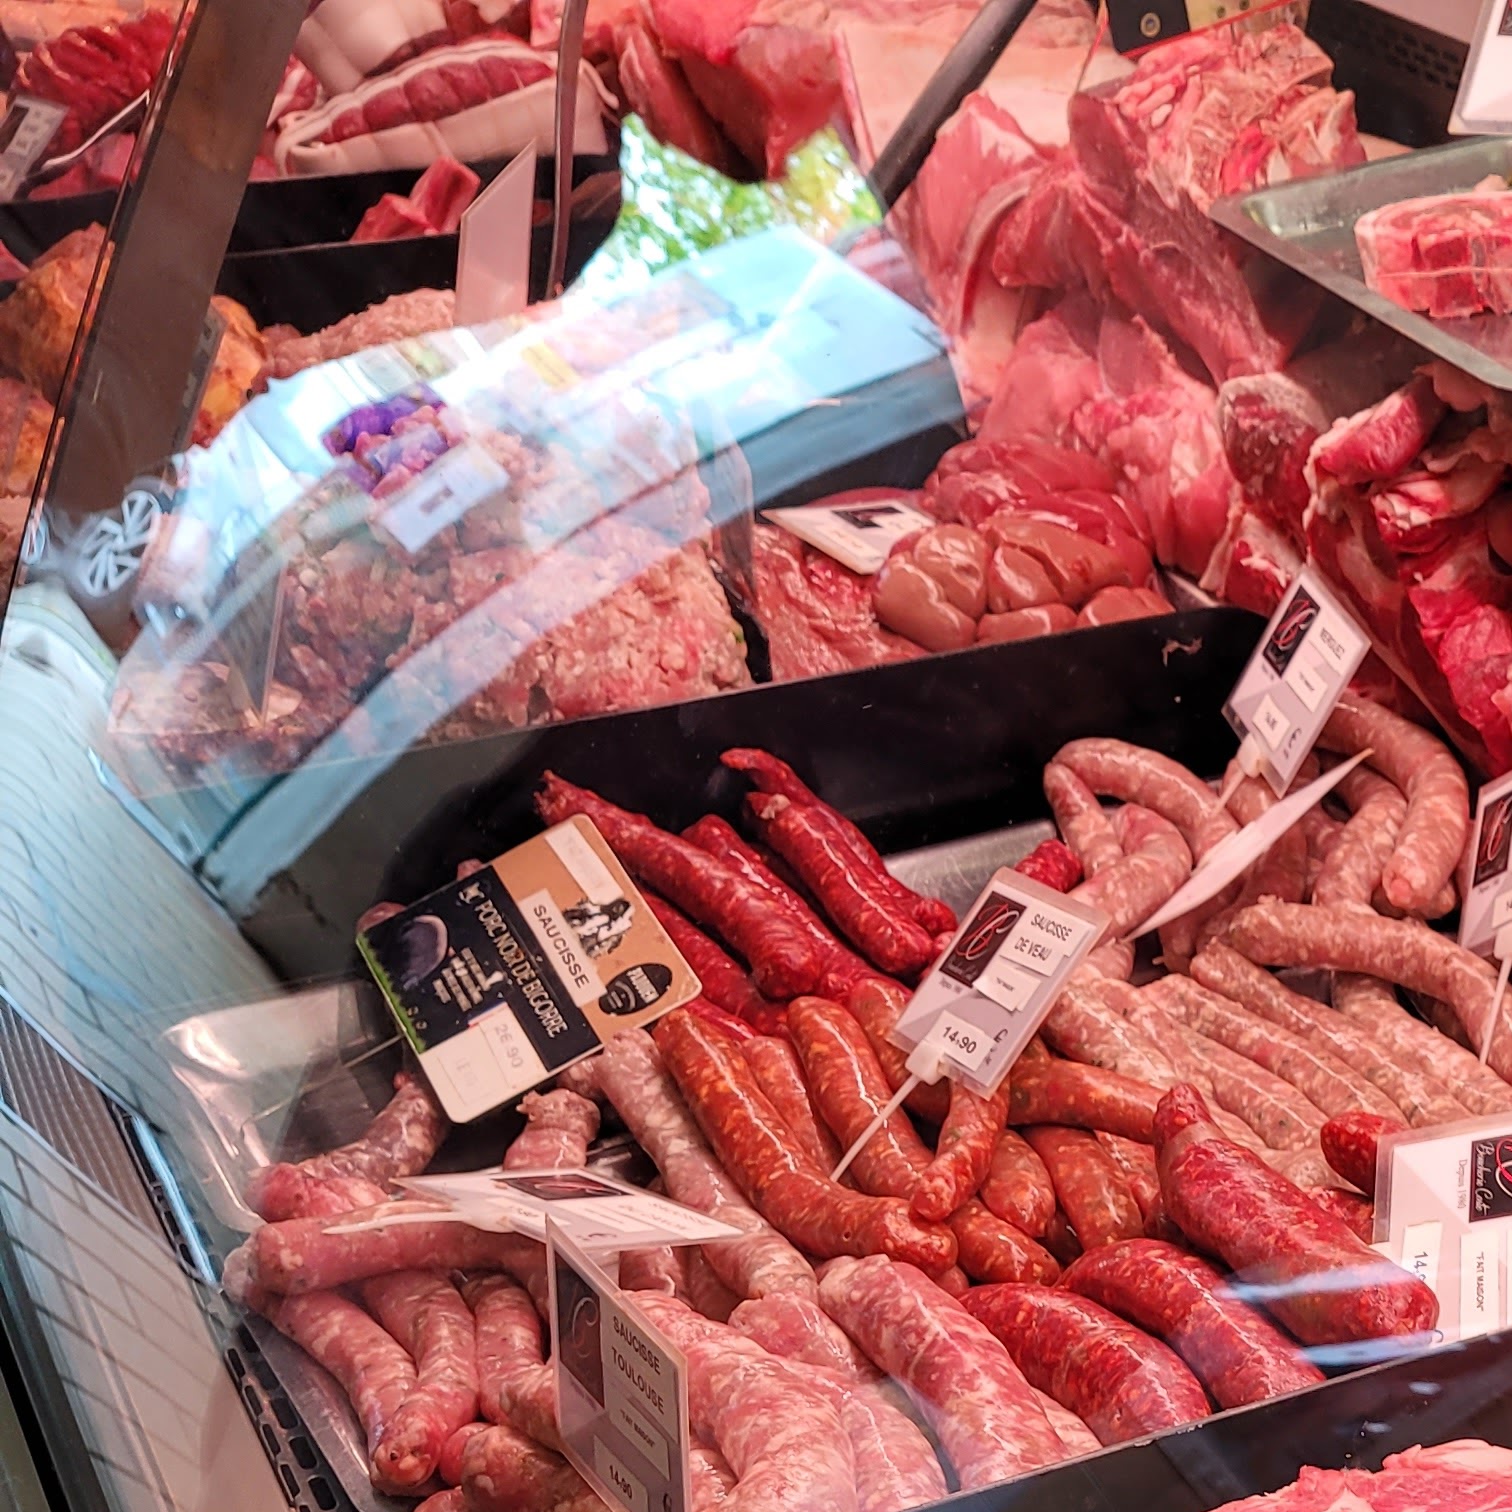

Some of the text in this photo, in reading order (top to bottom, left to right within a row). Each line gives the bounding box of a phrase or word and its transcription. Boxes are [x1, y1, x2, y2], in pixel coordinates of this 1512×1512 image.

[533, 903, 591, 990] SAUCISSE
[1014, 936, 1054, 962] DE VEAU
[1030, 912, 1073, 942] SAUCISSE
[522, 977, 570, 1040] BIGORRE
[612, 1315, 662, 1376] SAUCISSE
[611, 1345, 665, 1416] TOULOUSE
